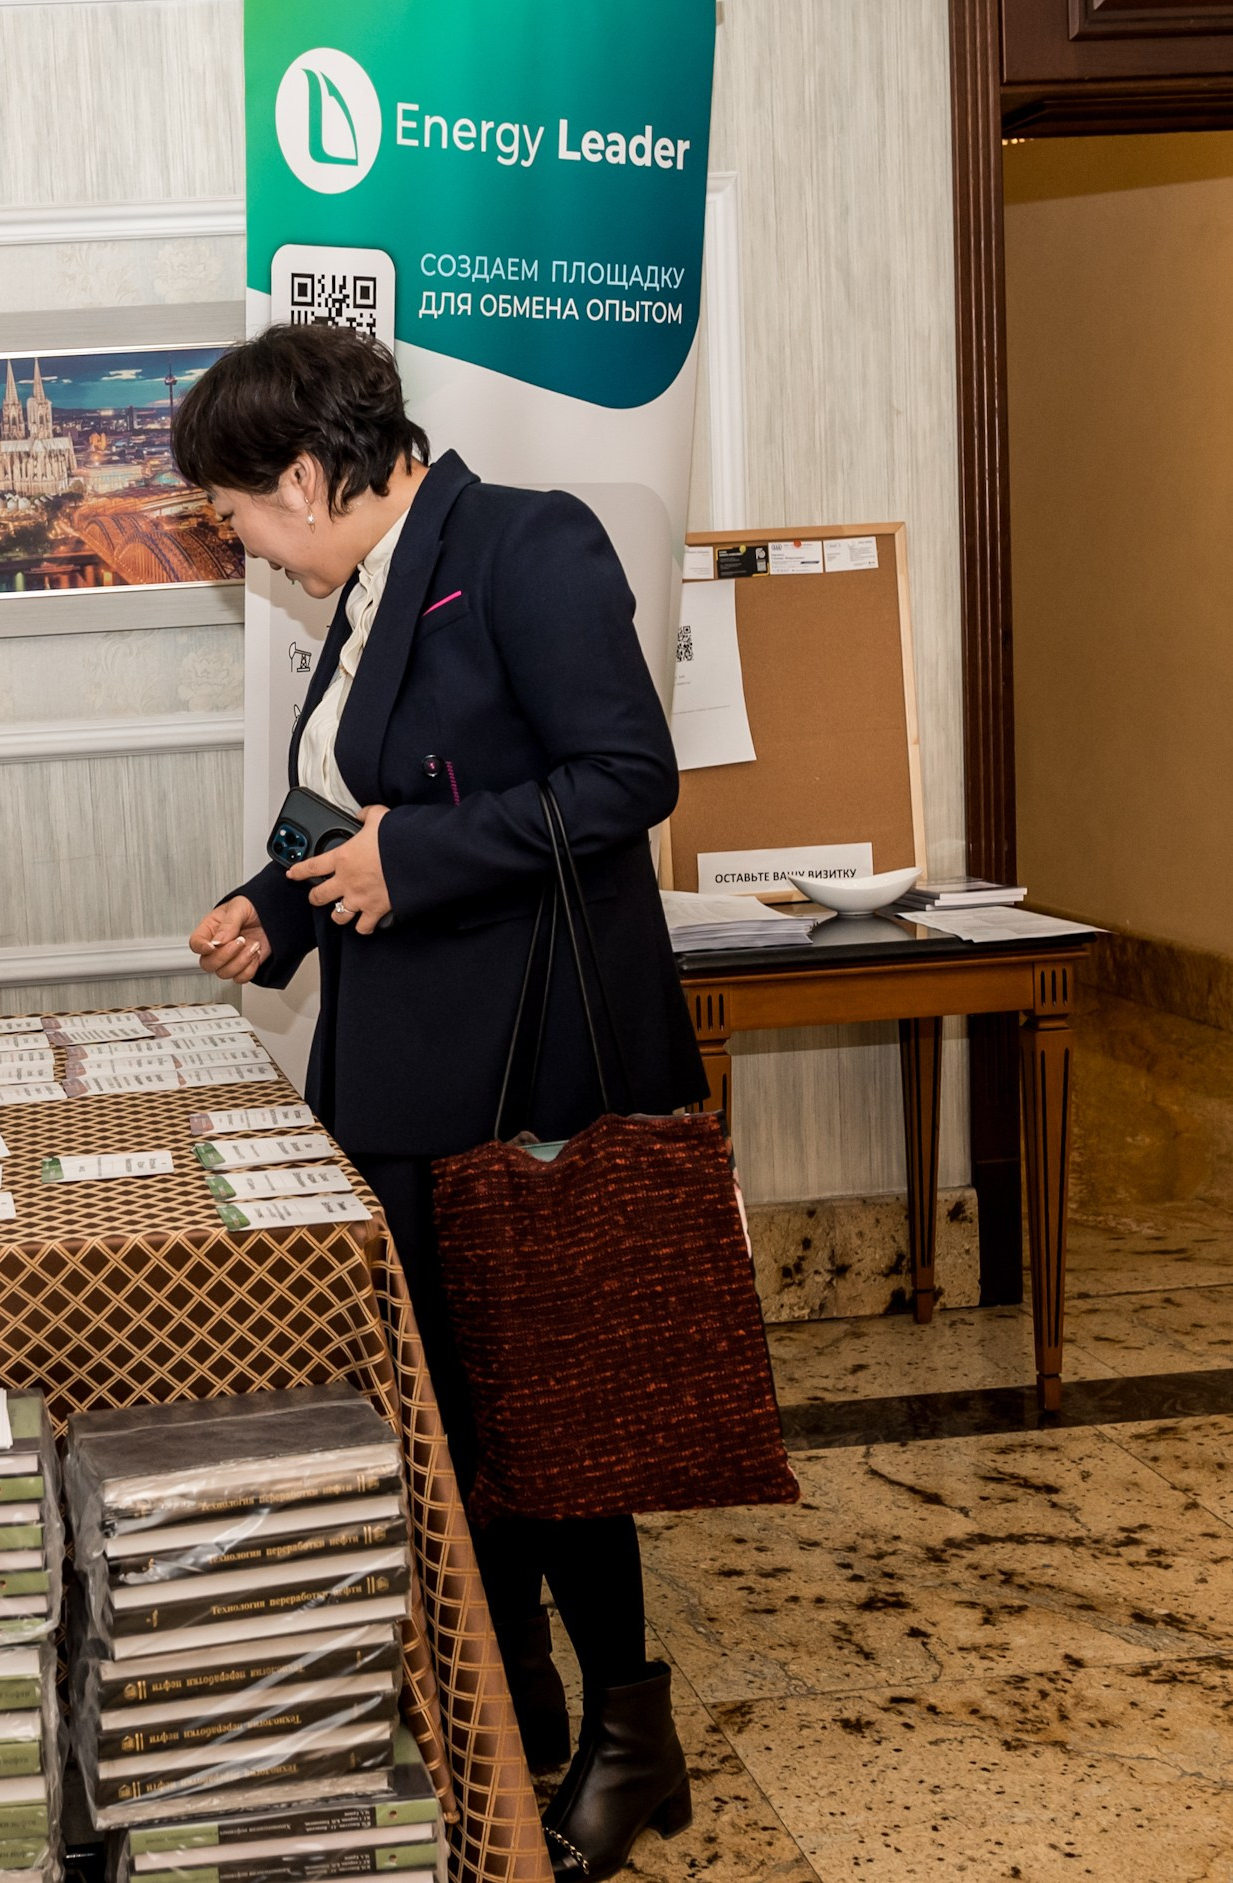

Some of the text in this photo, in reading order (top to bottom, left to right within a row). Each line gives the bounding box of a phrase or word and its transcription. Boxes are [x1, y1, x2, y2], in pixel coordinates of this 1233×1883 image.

[396, 102, 691, 170] Energy Leader
[420, 253, 685, 291] СОЗДАЕМ ПЛОЩАДКУ
[418, 291, 684, 325] ДЛЯ ОБМЕНА ОПЫТОМ
[715, 871, 770, 884] ОСТАВЬТЕ
[808, 868, 857, 879] ВИЗИТКУ
[329, 1535, 359, 1547] нефти
[211, 1600, 265, 1615] Технология
[152, 1679, 182, 1691] нефти
[186, 1670, 246, 1687] переработки
[149, 1731, 179, 1744] нефти
